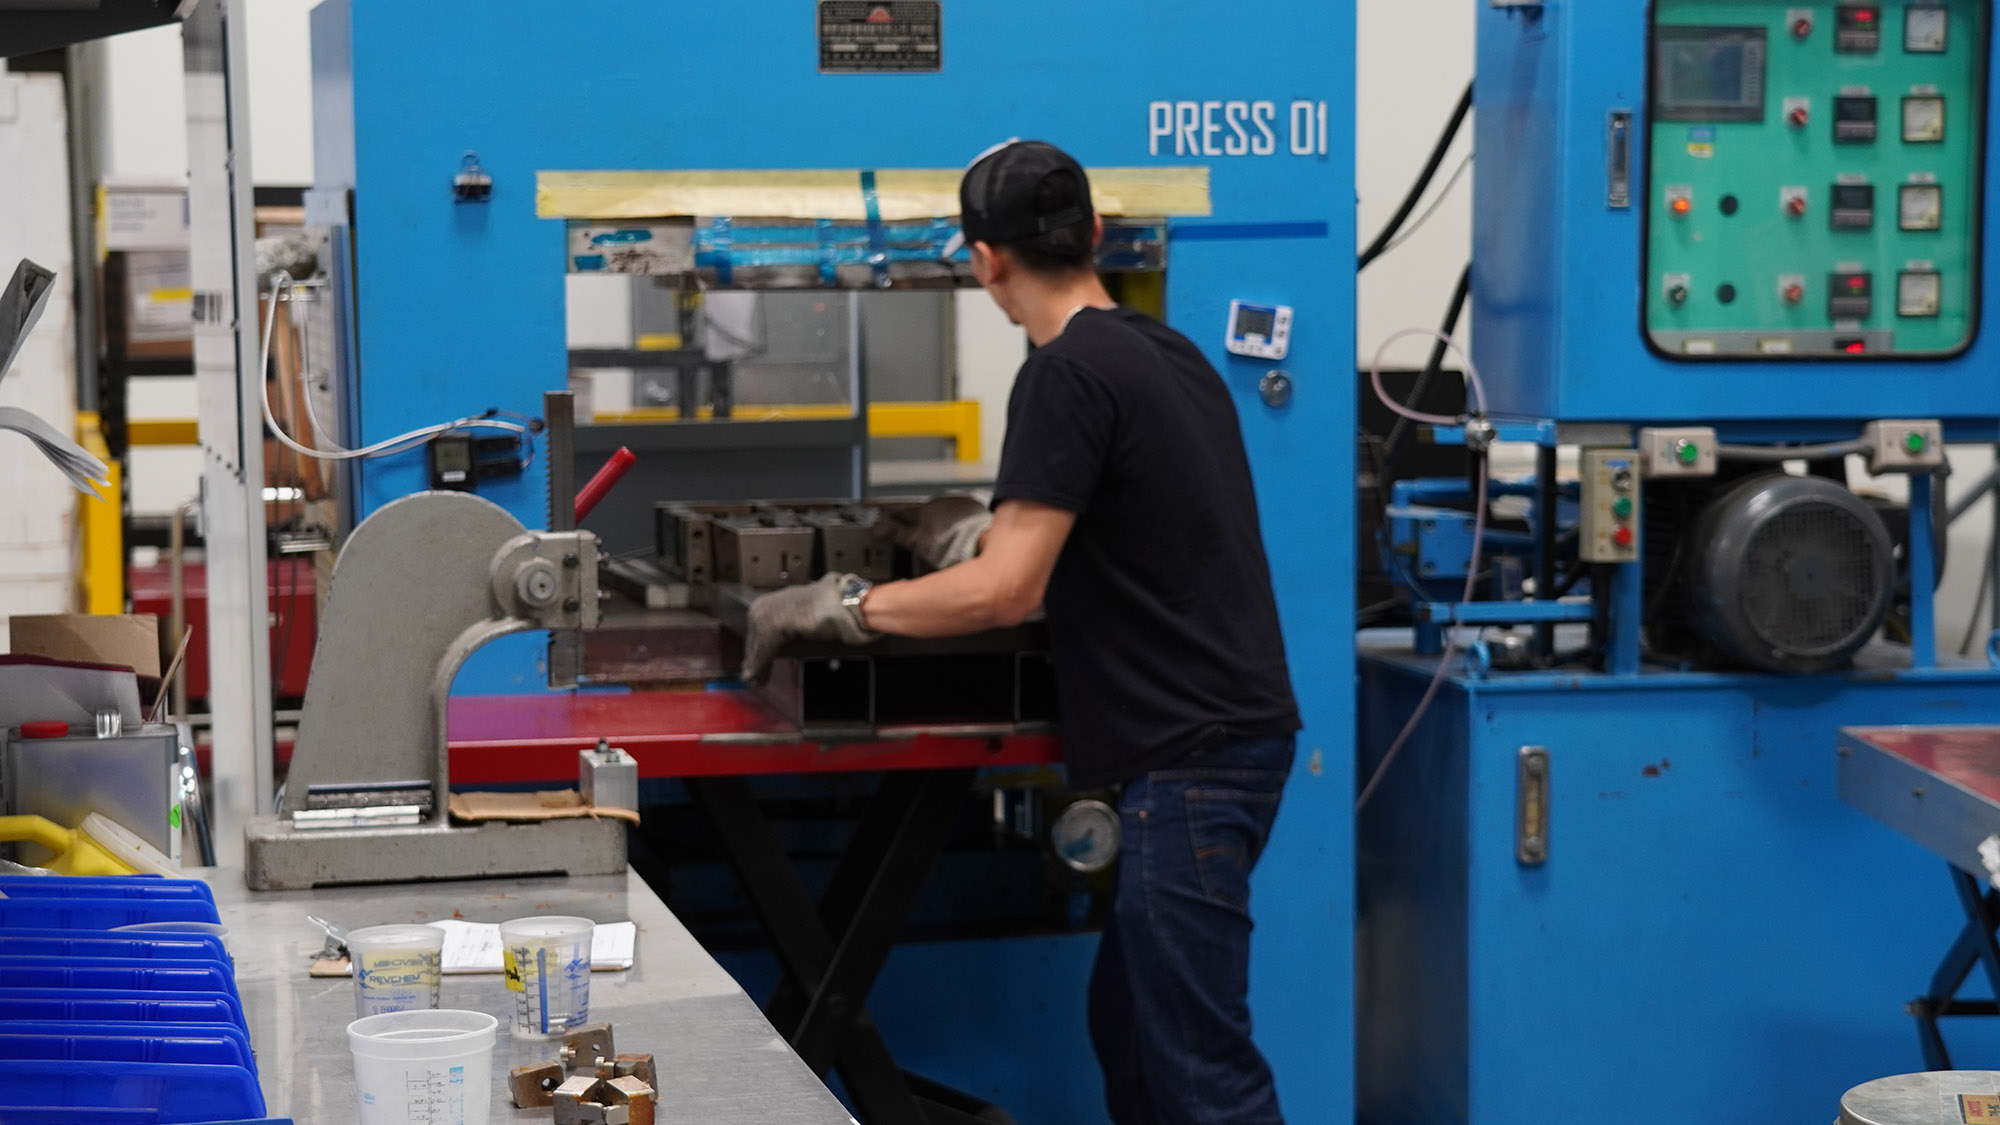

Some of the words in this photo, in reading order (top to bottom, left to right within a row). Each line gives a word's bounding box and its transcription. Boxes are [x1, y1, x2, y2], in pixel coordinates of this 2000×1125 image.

[1149, 101, 1276, 156] PRESS
[1290, 101, 1328, 156] 01
[369, 973, 421, 984] REVCHEM
